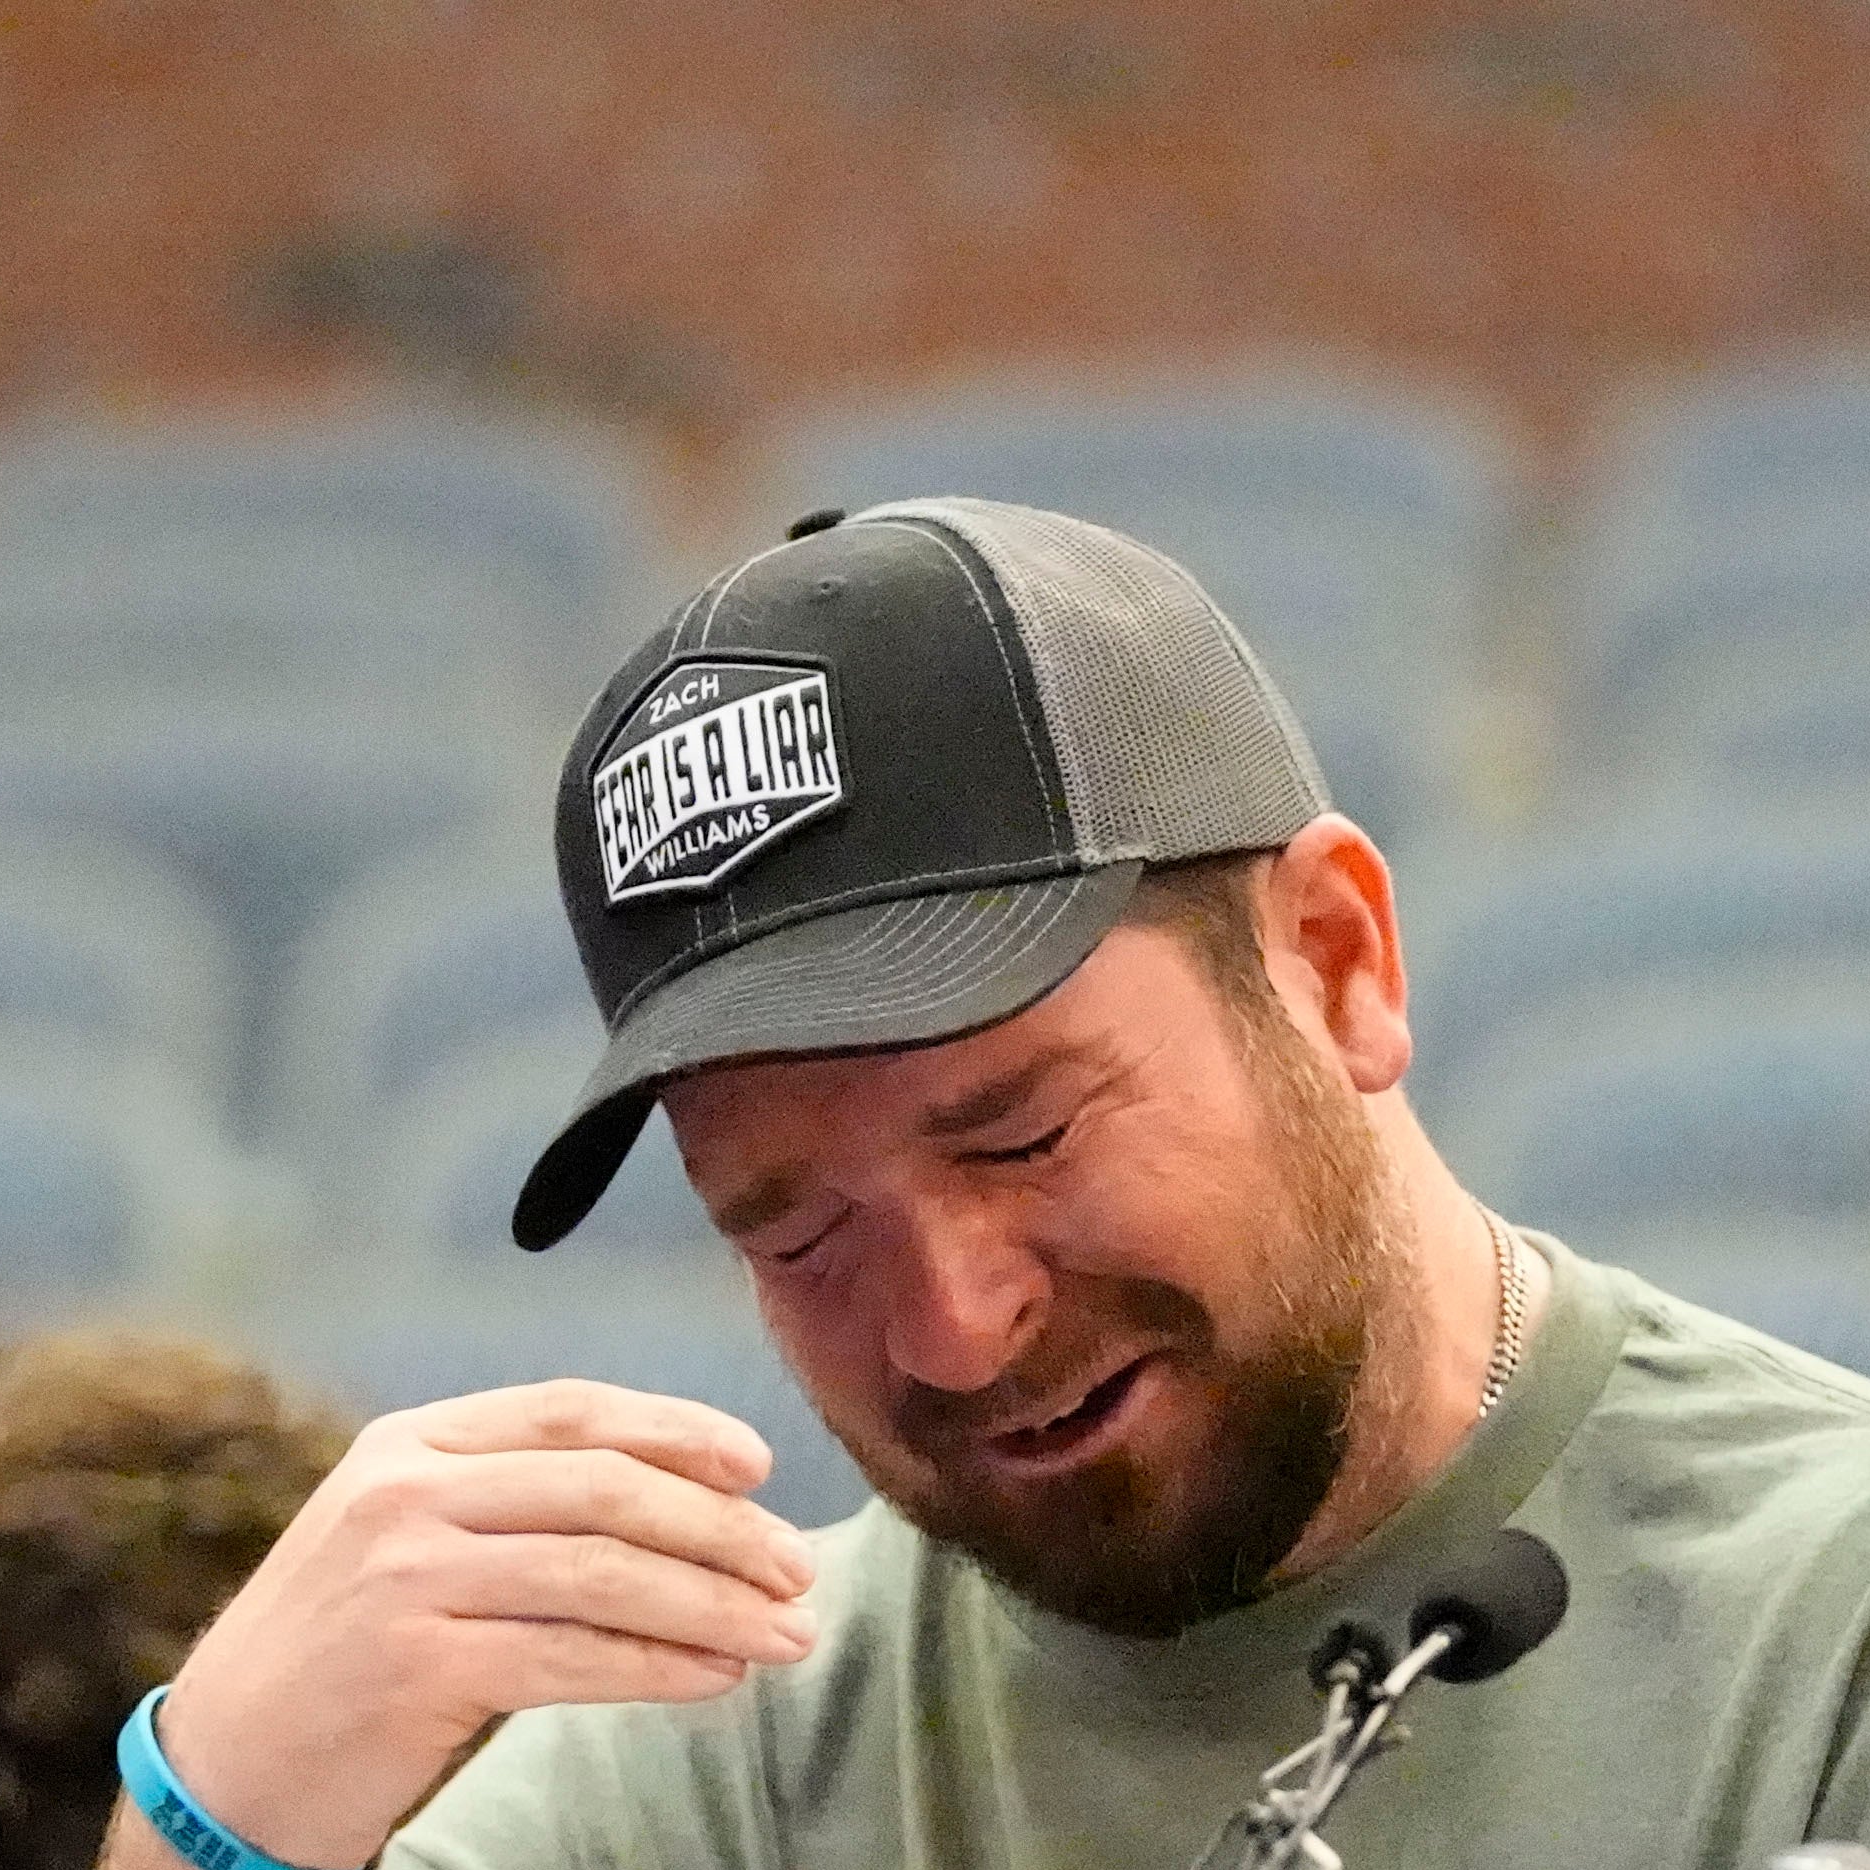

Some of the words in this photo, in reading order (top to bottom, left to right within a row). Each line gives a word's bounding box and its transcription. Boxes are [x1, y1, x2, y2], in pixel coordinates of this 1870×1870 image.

[649, 674, 720, 725] ZACH
[597, 751, 660, 886] FEAR
[661, 735, 696, 820] IS
[702, 718, 732, 802] A
[738, 684, 835, 792] LIAR
[644, 804, 771, 878] WILLIAMS
